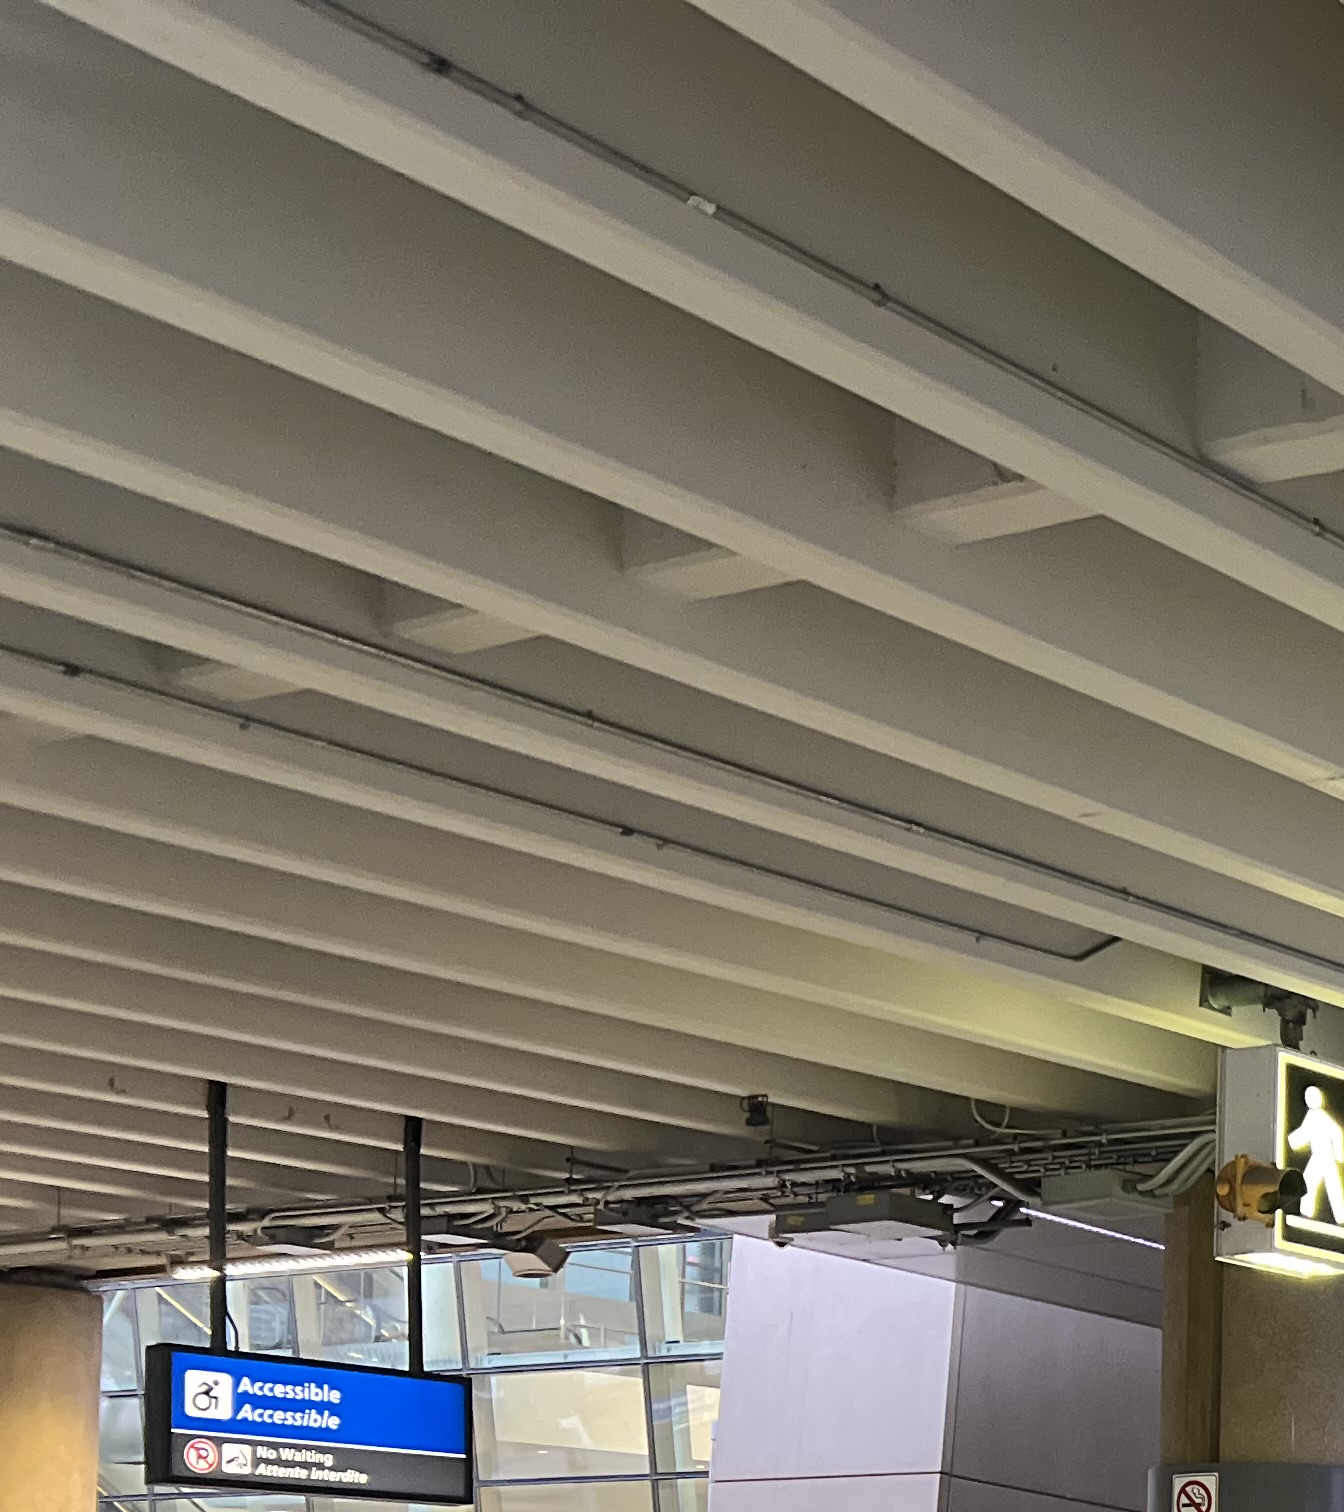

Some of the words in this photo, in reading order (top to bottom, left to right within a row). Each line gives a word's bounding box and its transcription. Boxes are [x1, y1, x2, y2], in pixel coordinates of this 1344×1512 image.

[237, 1376, 341, 1404] Accessible
[236, 1403, 341, 1430] Accessible
[256, 1445, 277, 1460] No
[279, 1447, 334, 1467] Waiting
[255, 1463, 309, 1479] Attente
